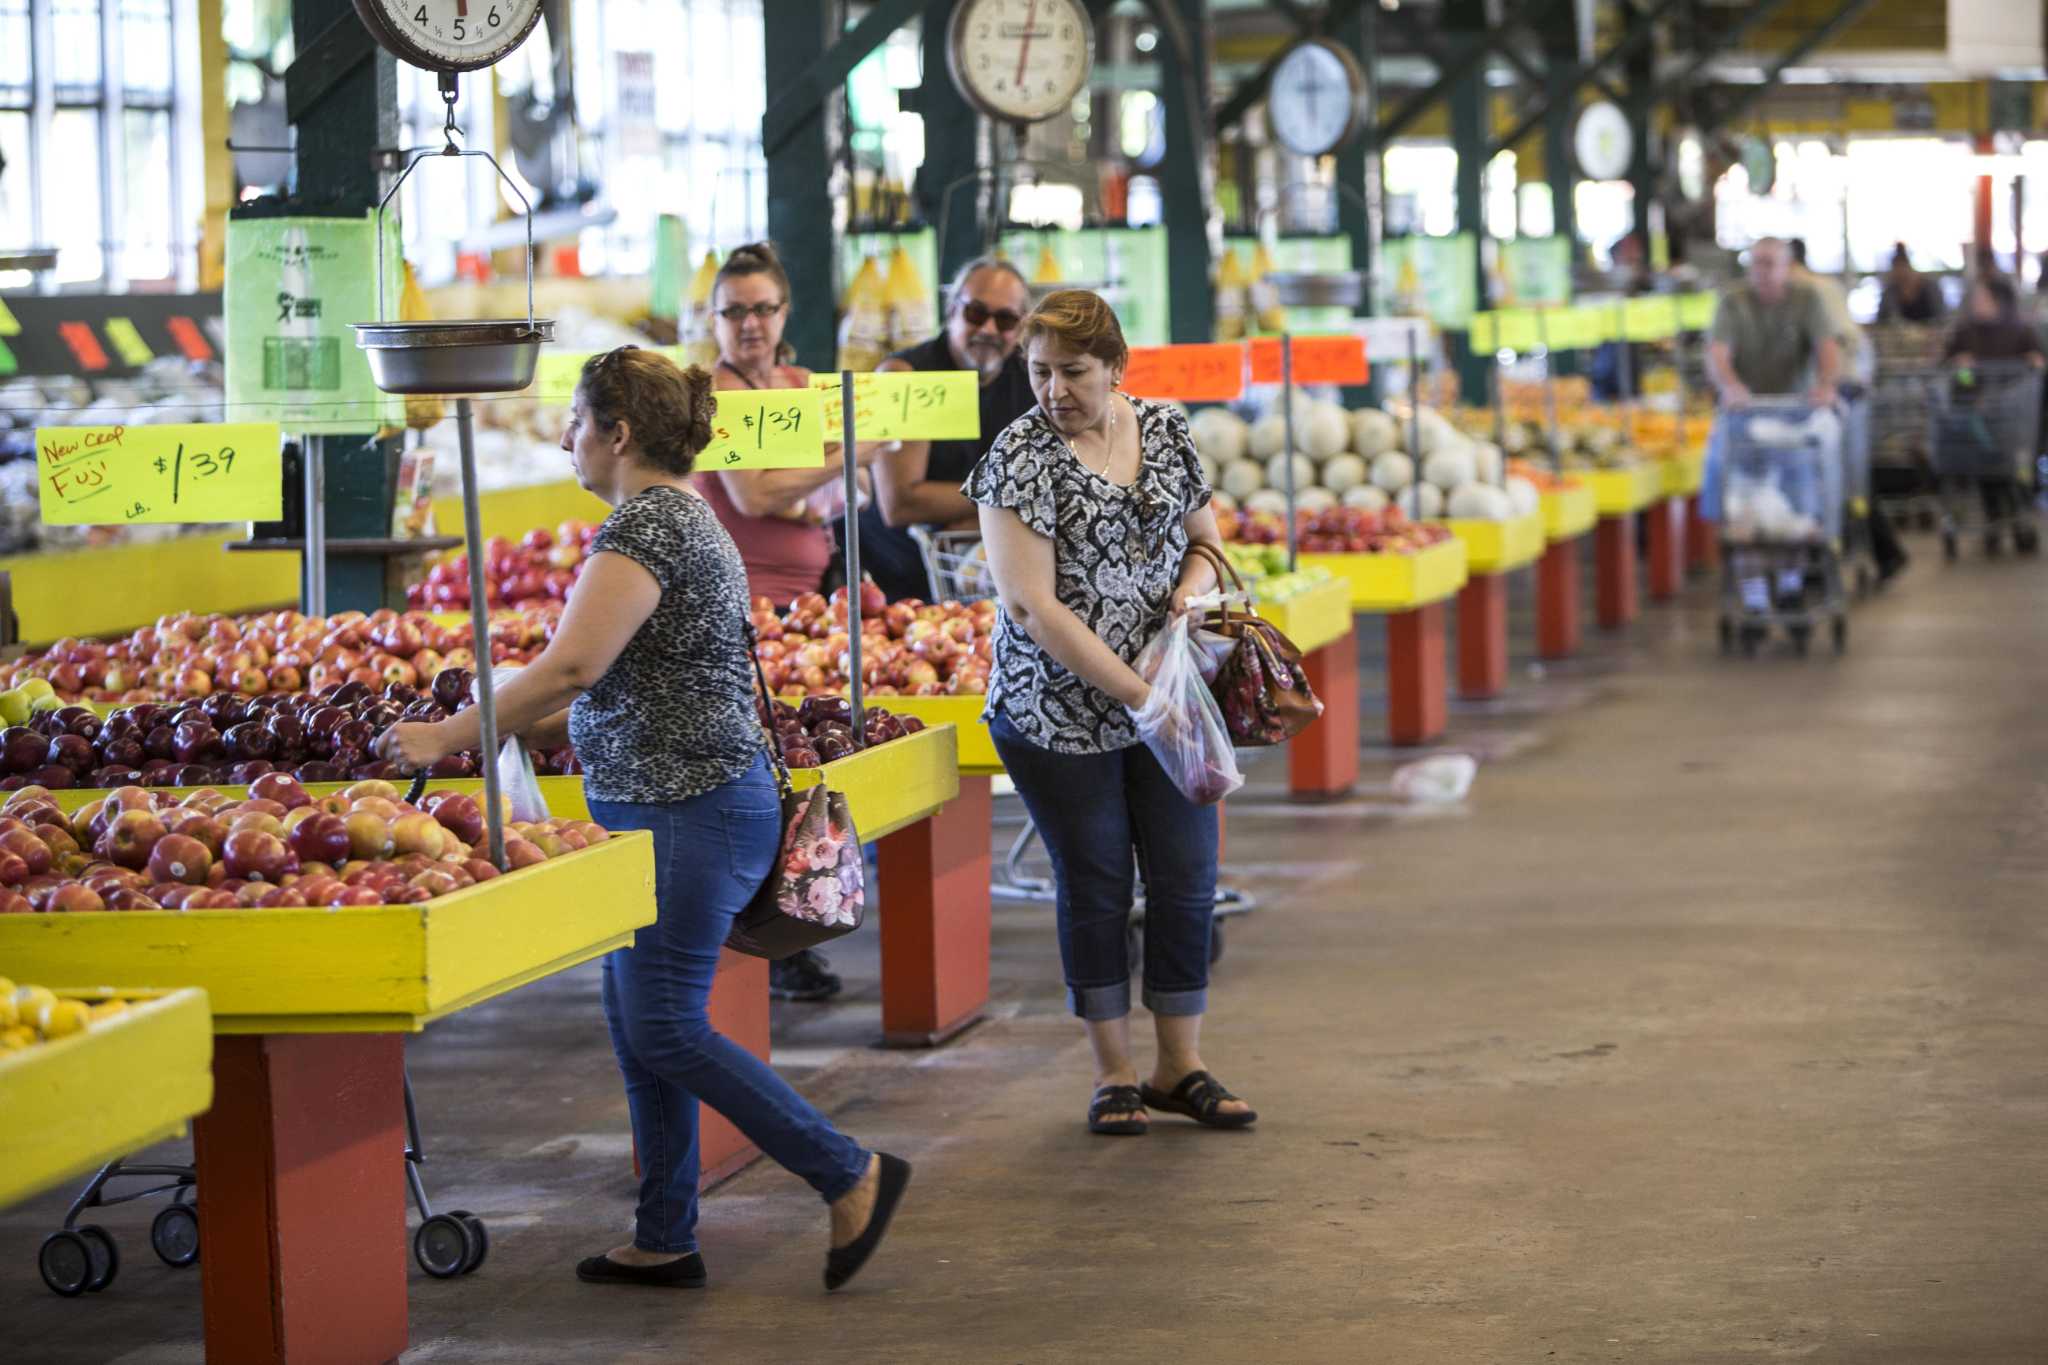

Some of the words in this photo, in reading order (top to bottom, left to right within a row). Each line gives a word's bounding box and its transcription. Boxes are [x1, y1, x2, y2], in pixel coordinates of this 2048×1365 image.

[414, 4, 429, 27] 4
[488, 5, 501, 27] 6
[453, 18, 466, 40] 5
[153, 442, 235, 505] $1.39
